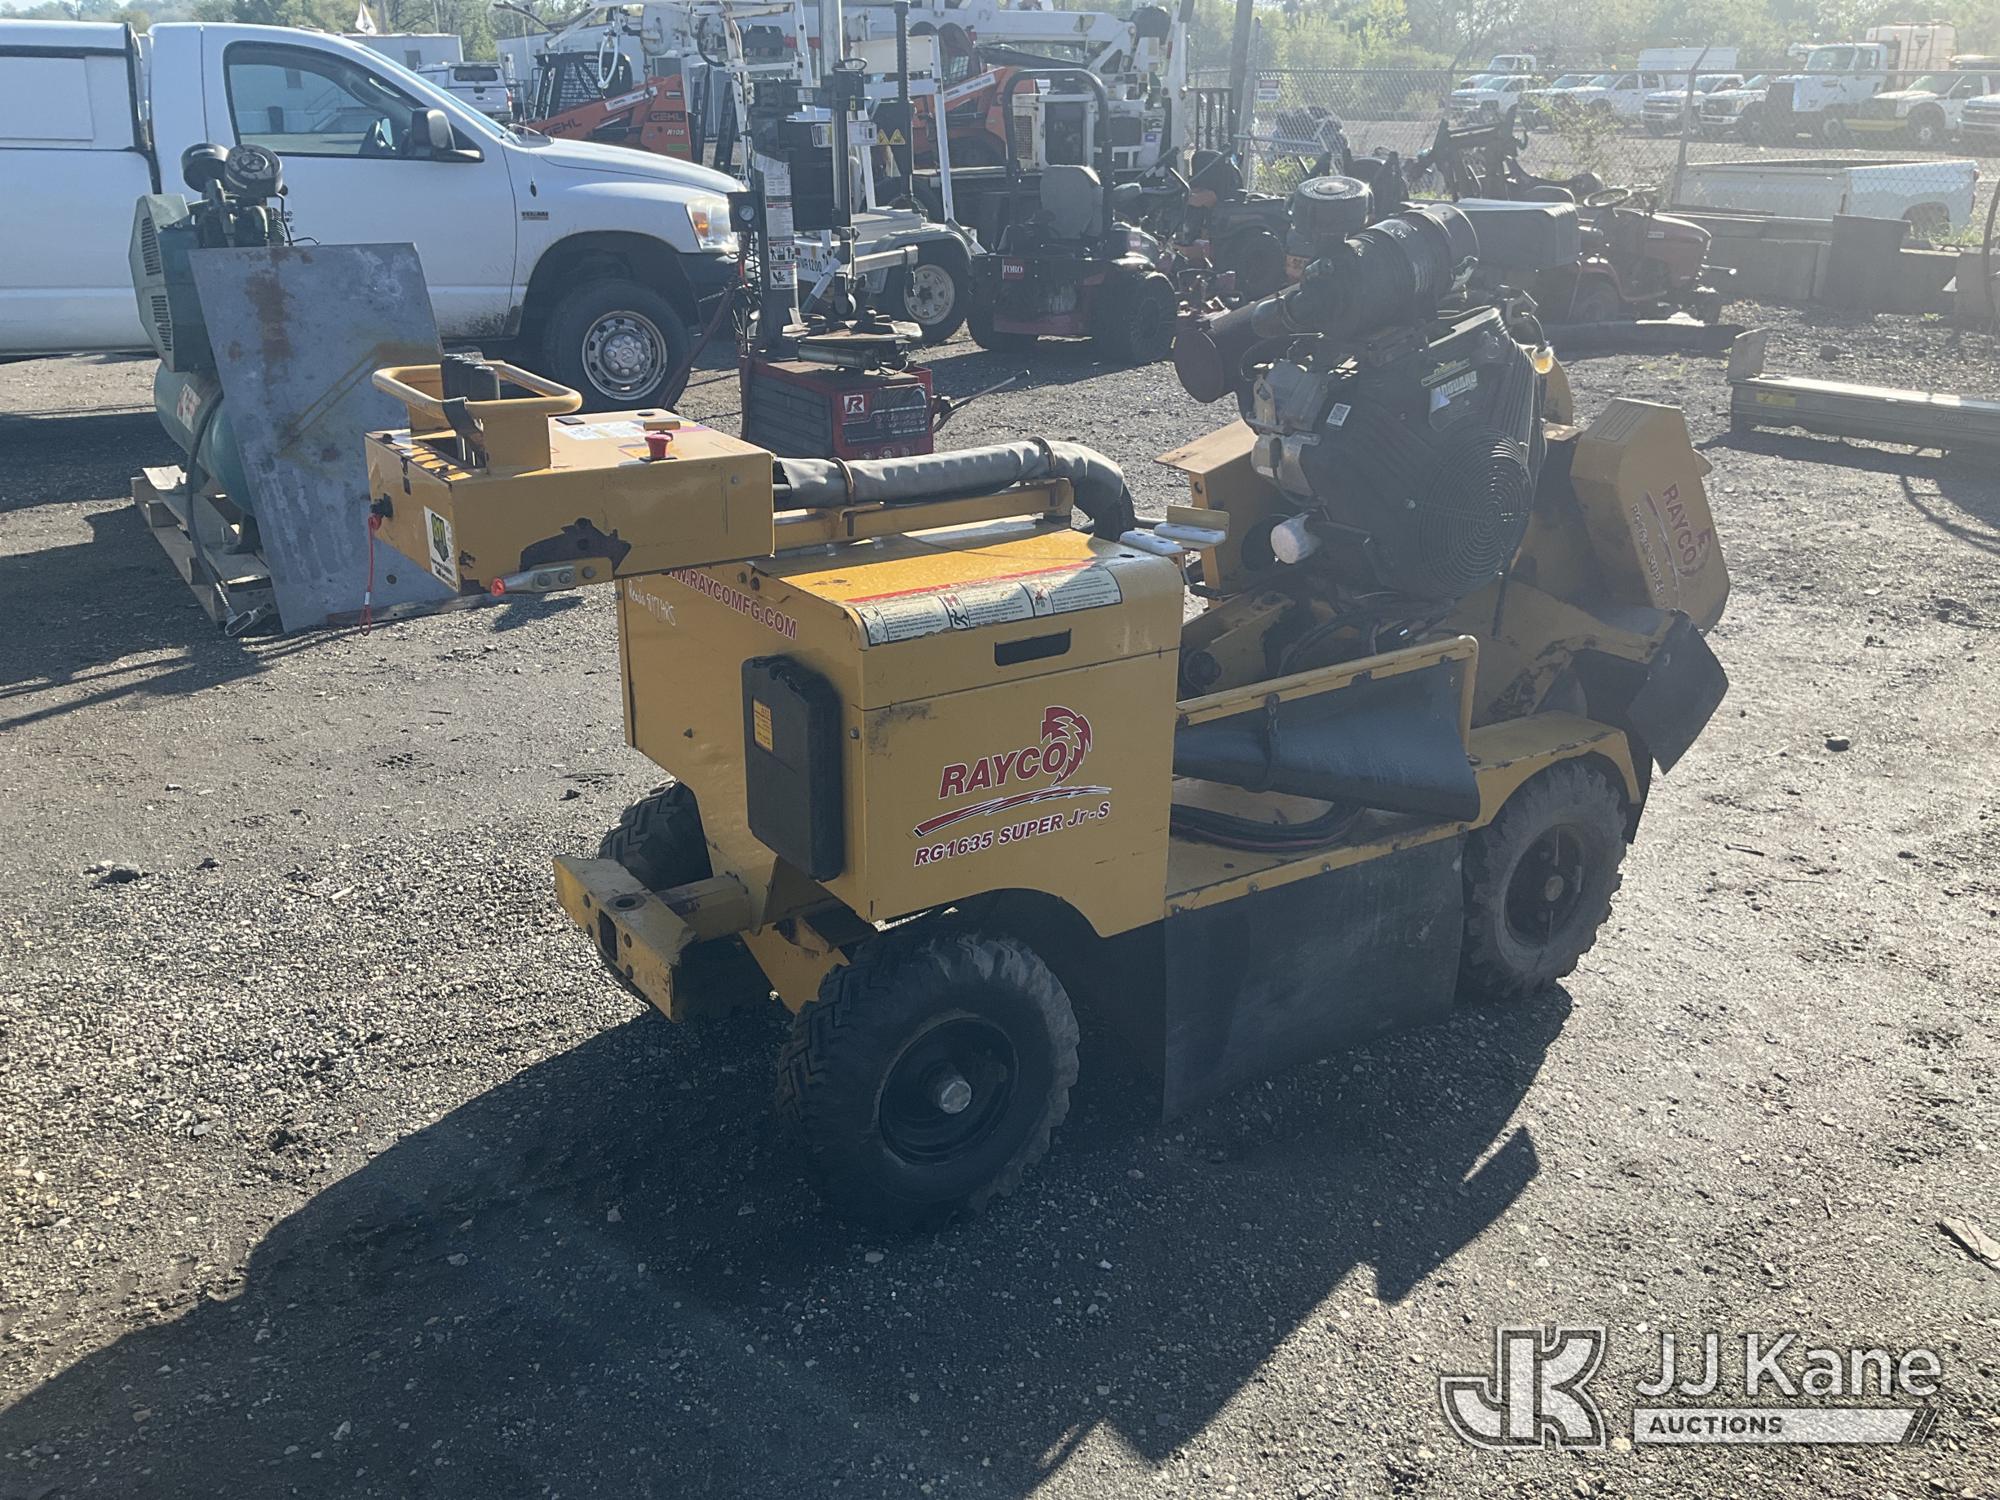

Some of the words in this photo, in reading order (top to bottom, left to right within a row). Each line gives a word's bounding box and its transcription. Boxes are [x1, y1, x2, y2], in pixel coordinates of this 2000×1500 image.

[542, 117, 583, 138] GEHL
[651, 111, 684, 122] GEHL
[1003, 265, 1023, 273] TORO
[1662, 482, 1698, 566] RAYCO
[938, 741, 1068, 800] RAYCO
[913, 830, 994, 867] RG1635
[998, 813, 1064, 844] SUPER
